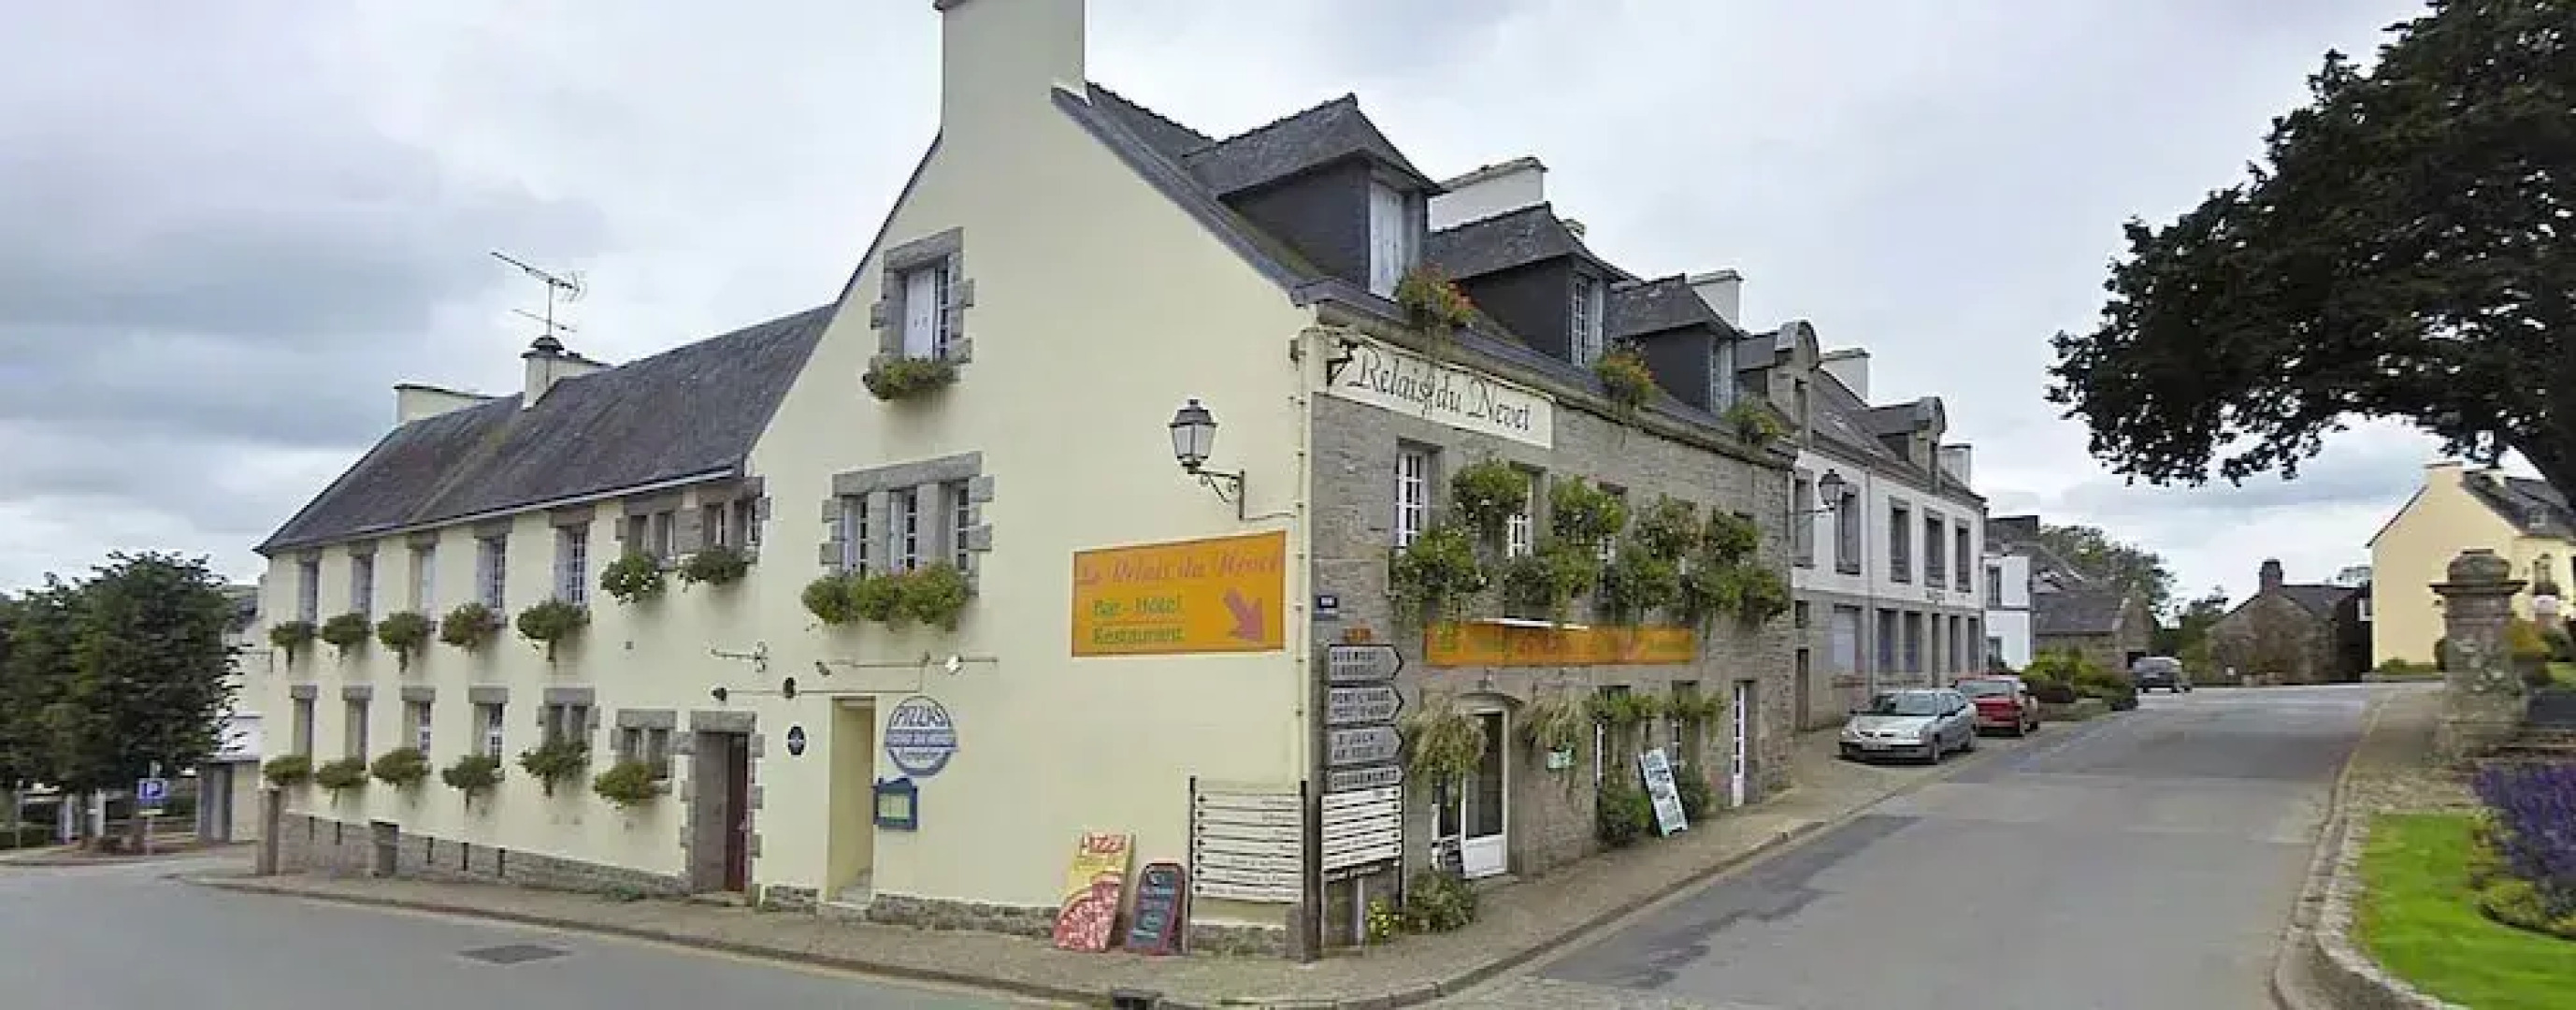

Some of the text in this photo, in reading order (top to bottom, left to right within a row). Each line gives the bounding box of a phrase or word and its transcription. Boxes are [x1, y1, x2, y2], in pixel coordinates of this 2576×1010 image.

[1346, 345, 1433, 403] Relais
[1435, 374, 1461, 413] du
[1093, 599, 1122, 617] Bar
[1093, 626, 1184, 646] Restaurant
[893, 704, 946, 727] PIZZAS
